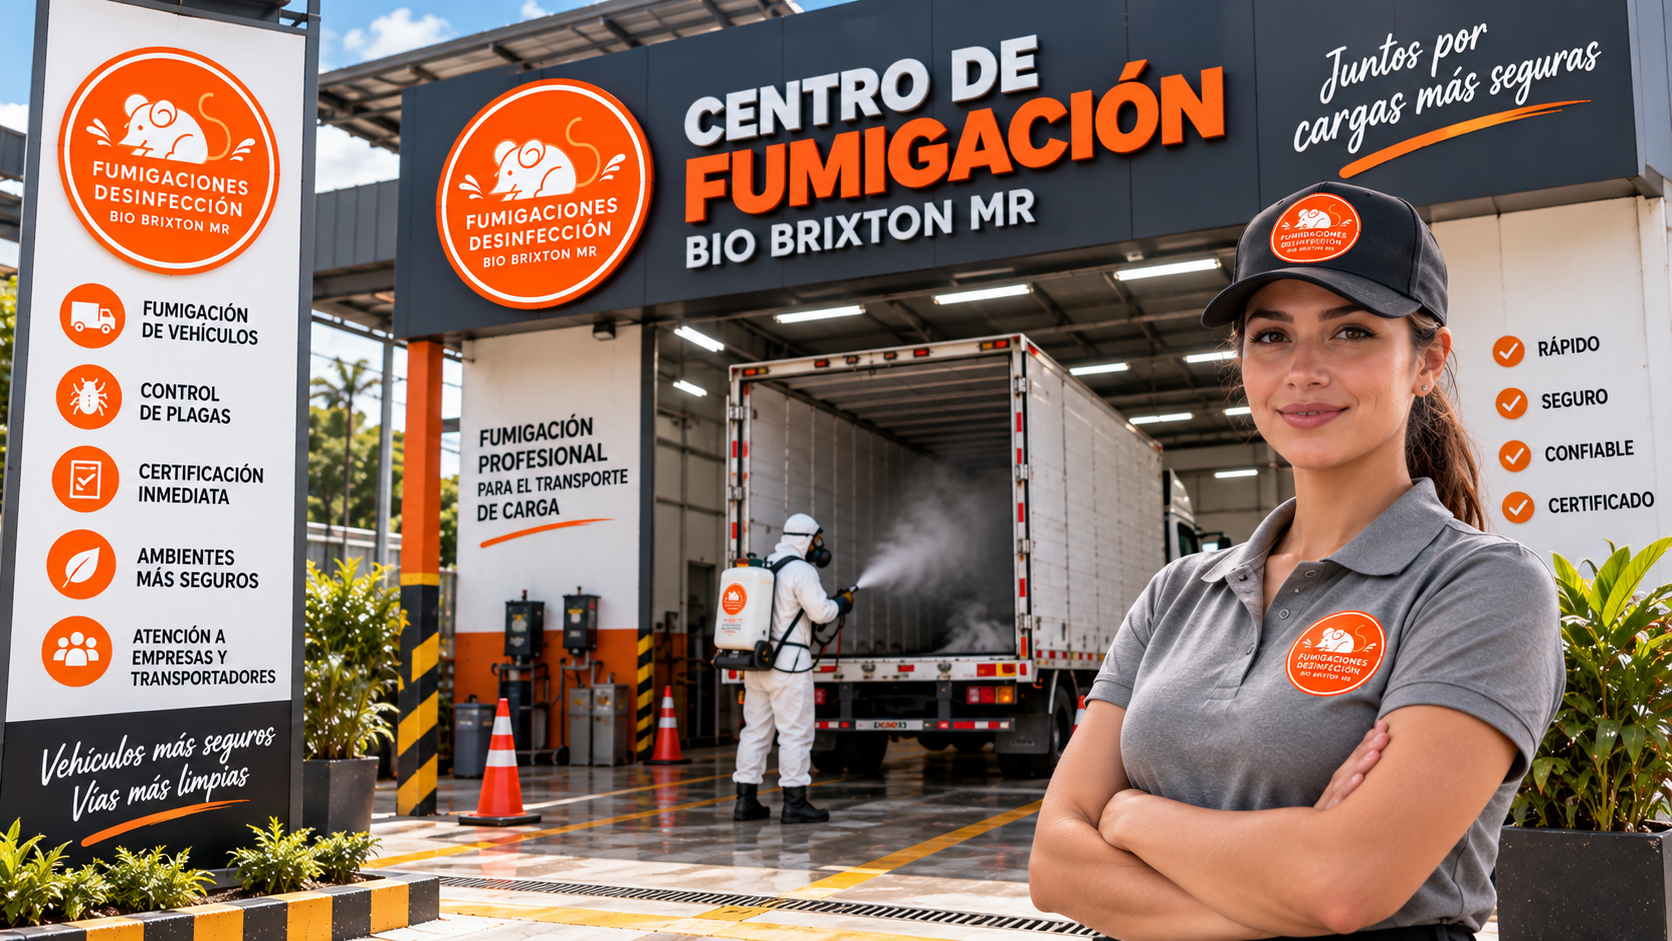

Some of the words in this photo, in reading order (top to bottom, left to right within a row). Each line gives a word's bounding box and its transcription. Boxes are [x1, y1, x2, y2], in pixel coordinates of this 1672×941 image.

[1319, 32, 1424, 105] Juntos
[1430, 22, 1488, 78] por
[683, 57, 931, 147] CENTRO
[951, 34, 1039, 103] DE
[1293, 90, 1407, 155] cargas
[1415, 66, 1481, 116] más
[1489, 40, 1602, 106] seguras
[684, 58, 1226, 224] FUMIGACIÓN
[92, 160, 249, 196] FUMIGACIONES
[94, 184, 243, 217] DESINFECCIÓN
[110, 210, 135, 224] BIO
[141, 214, 204, 232] BRIXTON
[209, 222, 230, 235] MR
[466, 197, 618, 230] FUMIGACIONES
[469, 218, 611, 251] DESINFECCIÓN
[685, 227, 757, 270] BIO
[770, 199, 953, 258] BRIXTON
[969, 187, 1037, 231] MR
[483, 255, 506, 268] BIO
[511, 248, 571, 265] BRIXTON
[576, 246, 597, 258] MR
[143, 300, 248, 323] FUMIGACIÓN
[142, 322, 163, 339] DE
[168, 322, 258, 345] VEHÍCULOS
[1538, 335, 1600, 357] RÁPIDO
[140, 382, 220, 402] CONTROL
[1541, 388, 1608, 410] SEGURO
[140, 405, 161, 421] DE
[166, 406, 231, 424] PLAGAS
[479, 413, 593, 447] FUMIGACIÓN
[478, 442, 608, 474] PROFESIONAL
[1545, 440, 1635, 462] CONFIABLE
[139, 463, 264, 484] CERTIFICACIÓN
[478, 479, 513, 497] PARA
[517, 478, 532, 494] EL
[535, 468, 629, 492] TRANSPORTE
[138, 486, 230, 505] INMEDIATA
[1548, 491, 1655, 514] CERTIFICADO
[477, 503, 498, 522] DE
[502, 498, 560, 519] CARGA
[137, 547, 235, 566] AMBIENTES
[136, 567, 175, 588] MÁS
[179, 571, 259, 589] SEGUROS
[132, 625, 211, 644] ATENCIÓN
[215, 629, 226, 644] A
[132, 650, 214, 665] EMPRESAS
[217, 649, 228, 665] Y
[131, 669, 276, 687] TRANSPORTADORES
[40, 734, 147, 787] Vehículos
[152, 731, 198, 762] más
[202, 726, 276, 764] seguros
[72, 780, 121, 822] Vías
[127, 774, 171, 806] más
[177, 763, 250, 803] limpias
